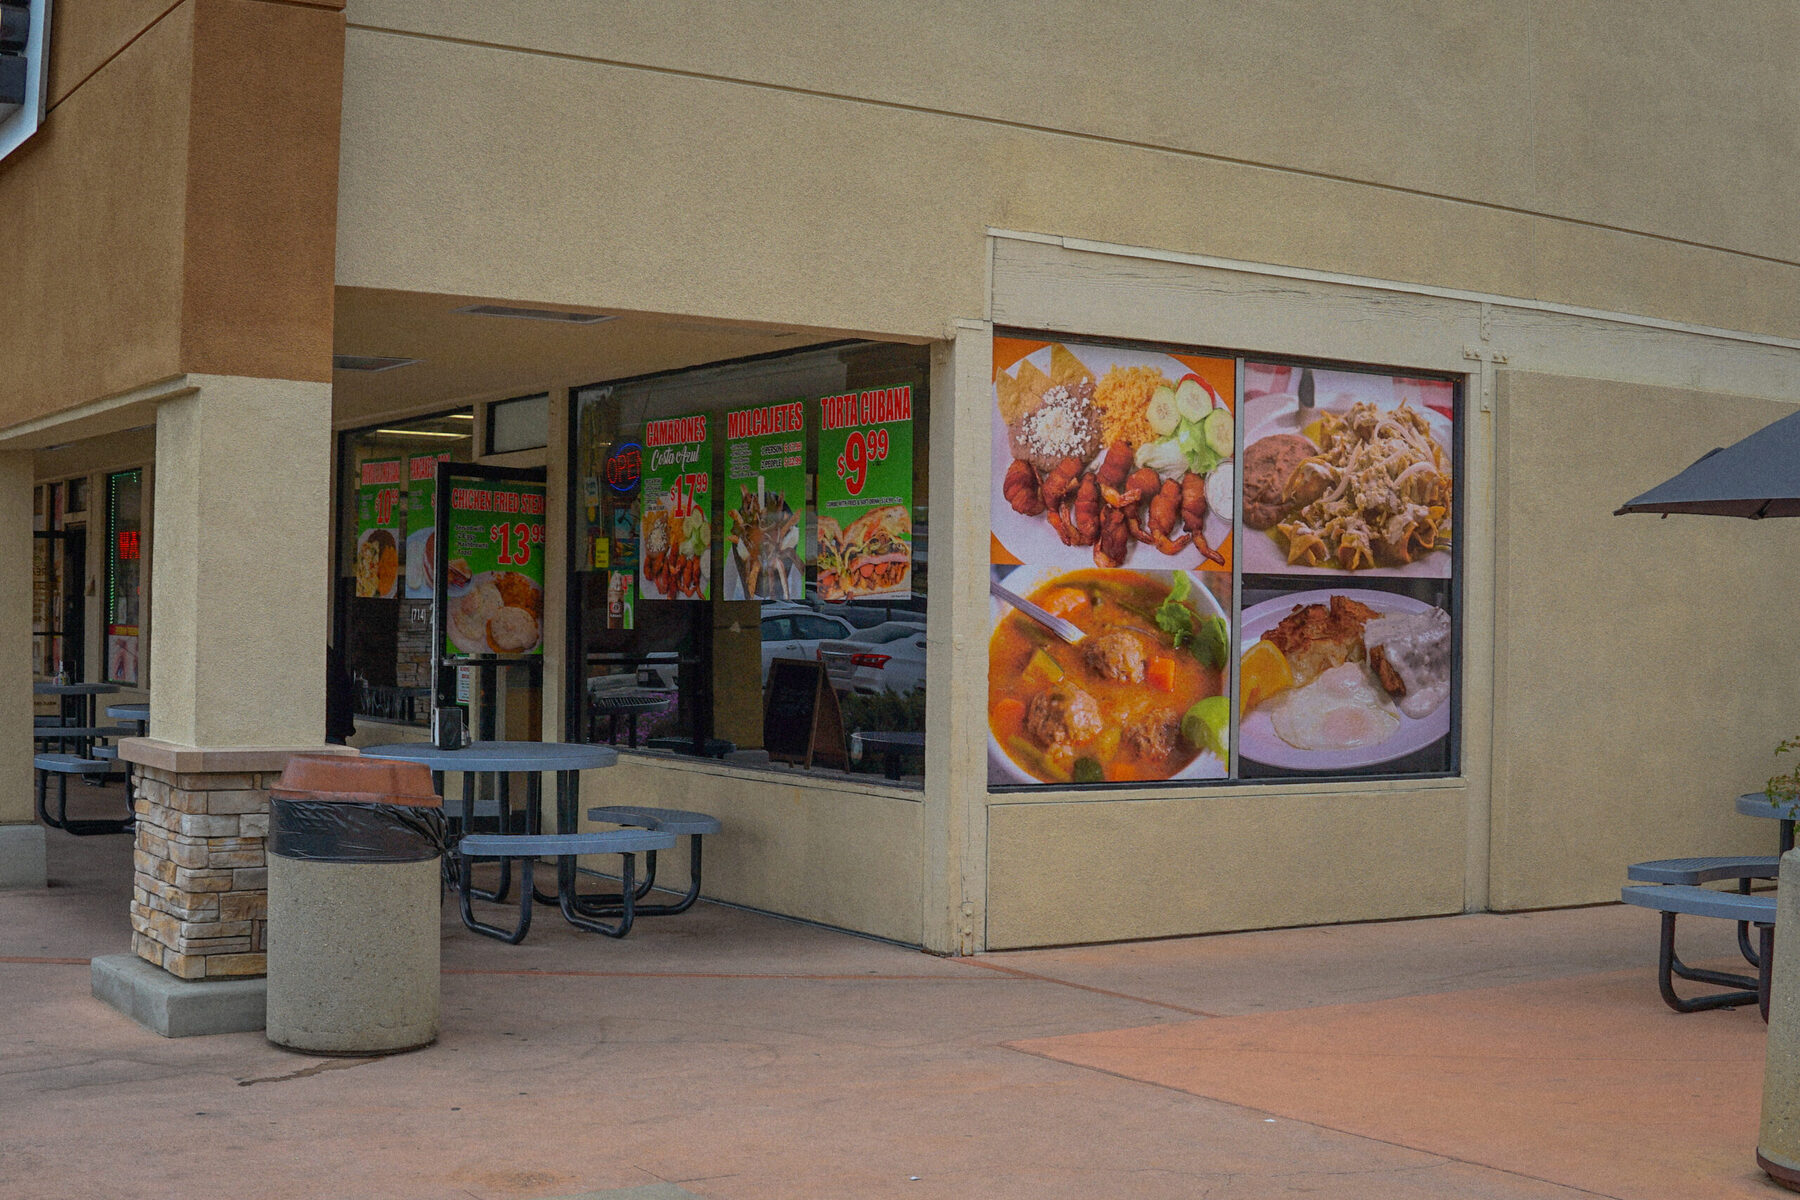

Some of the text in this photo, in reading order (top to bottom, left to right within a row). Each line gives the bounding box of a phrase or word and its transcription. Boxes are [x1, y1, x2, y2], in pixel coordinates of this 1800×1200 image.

[728, 401, 804, 440] MOLCAJETES
[821, 386, 912, 430] TORTA CUBANA
[646, 415, 706, 447] CAMARONES
[651, 446, 675, 472] Costa
[675, 444, 700, 473] Azul
[452, 487, 492, 511] CHICKEN
[493, 491, 519, 513] FRIED
[520, 493, 545, 515] STEA
[411, 608, 426, 624] (714)
